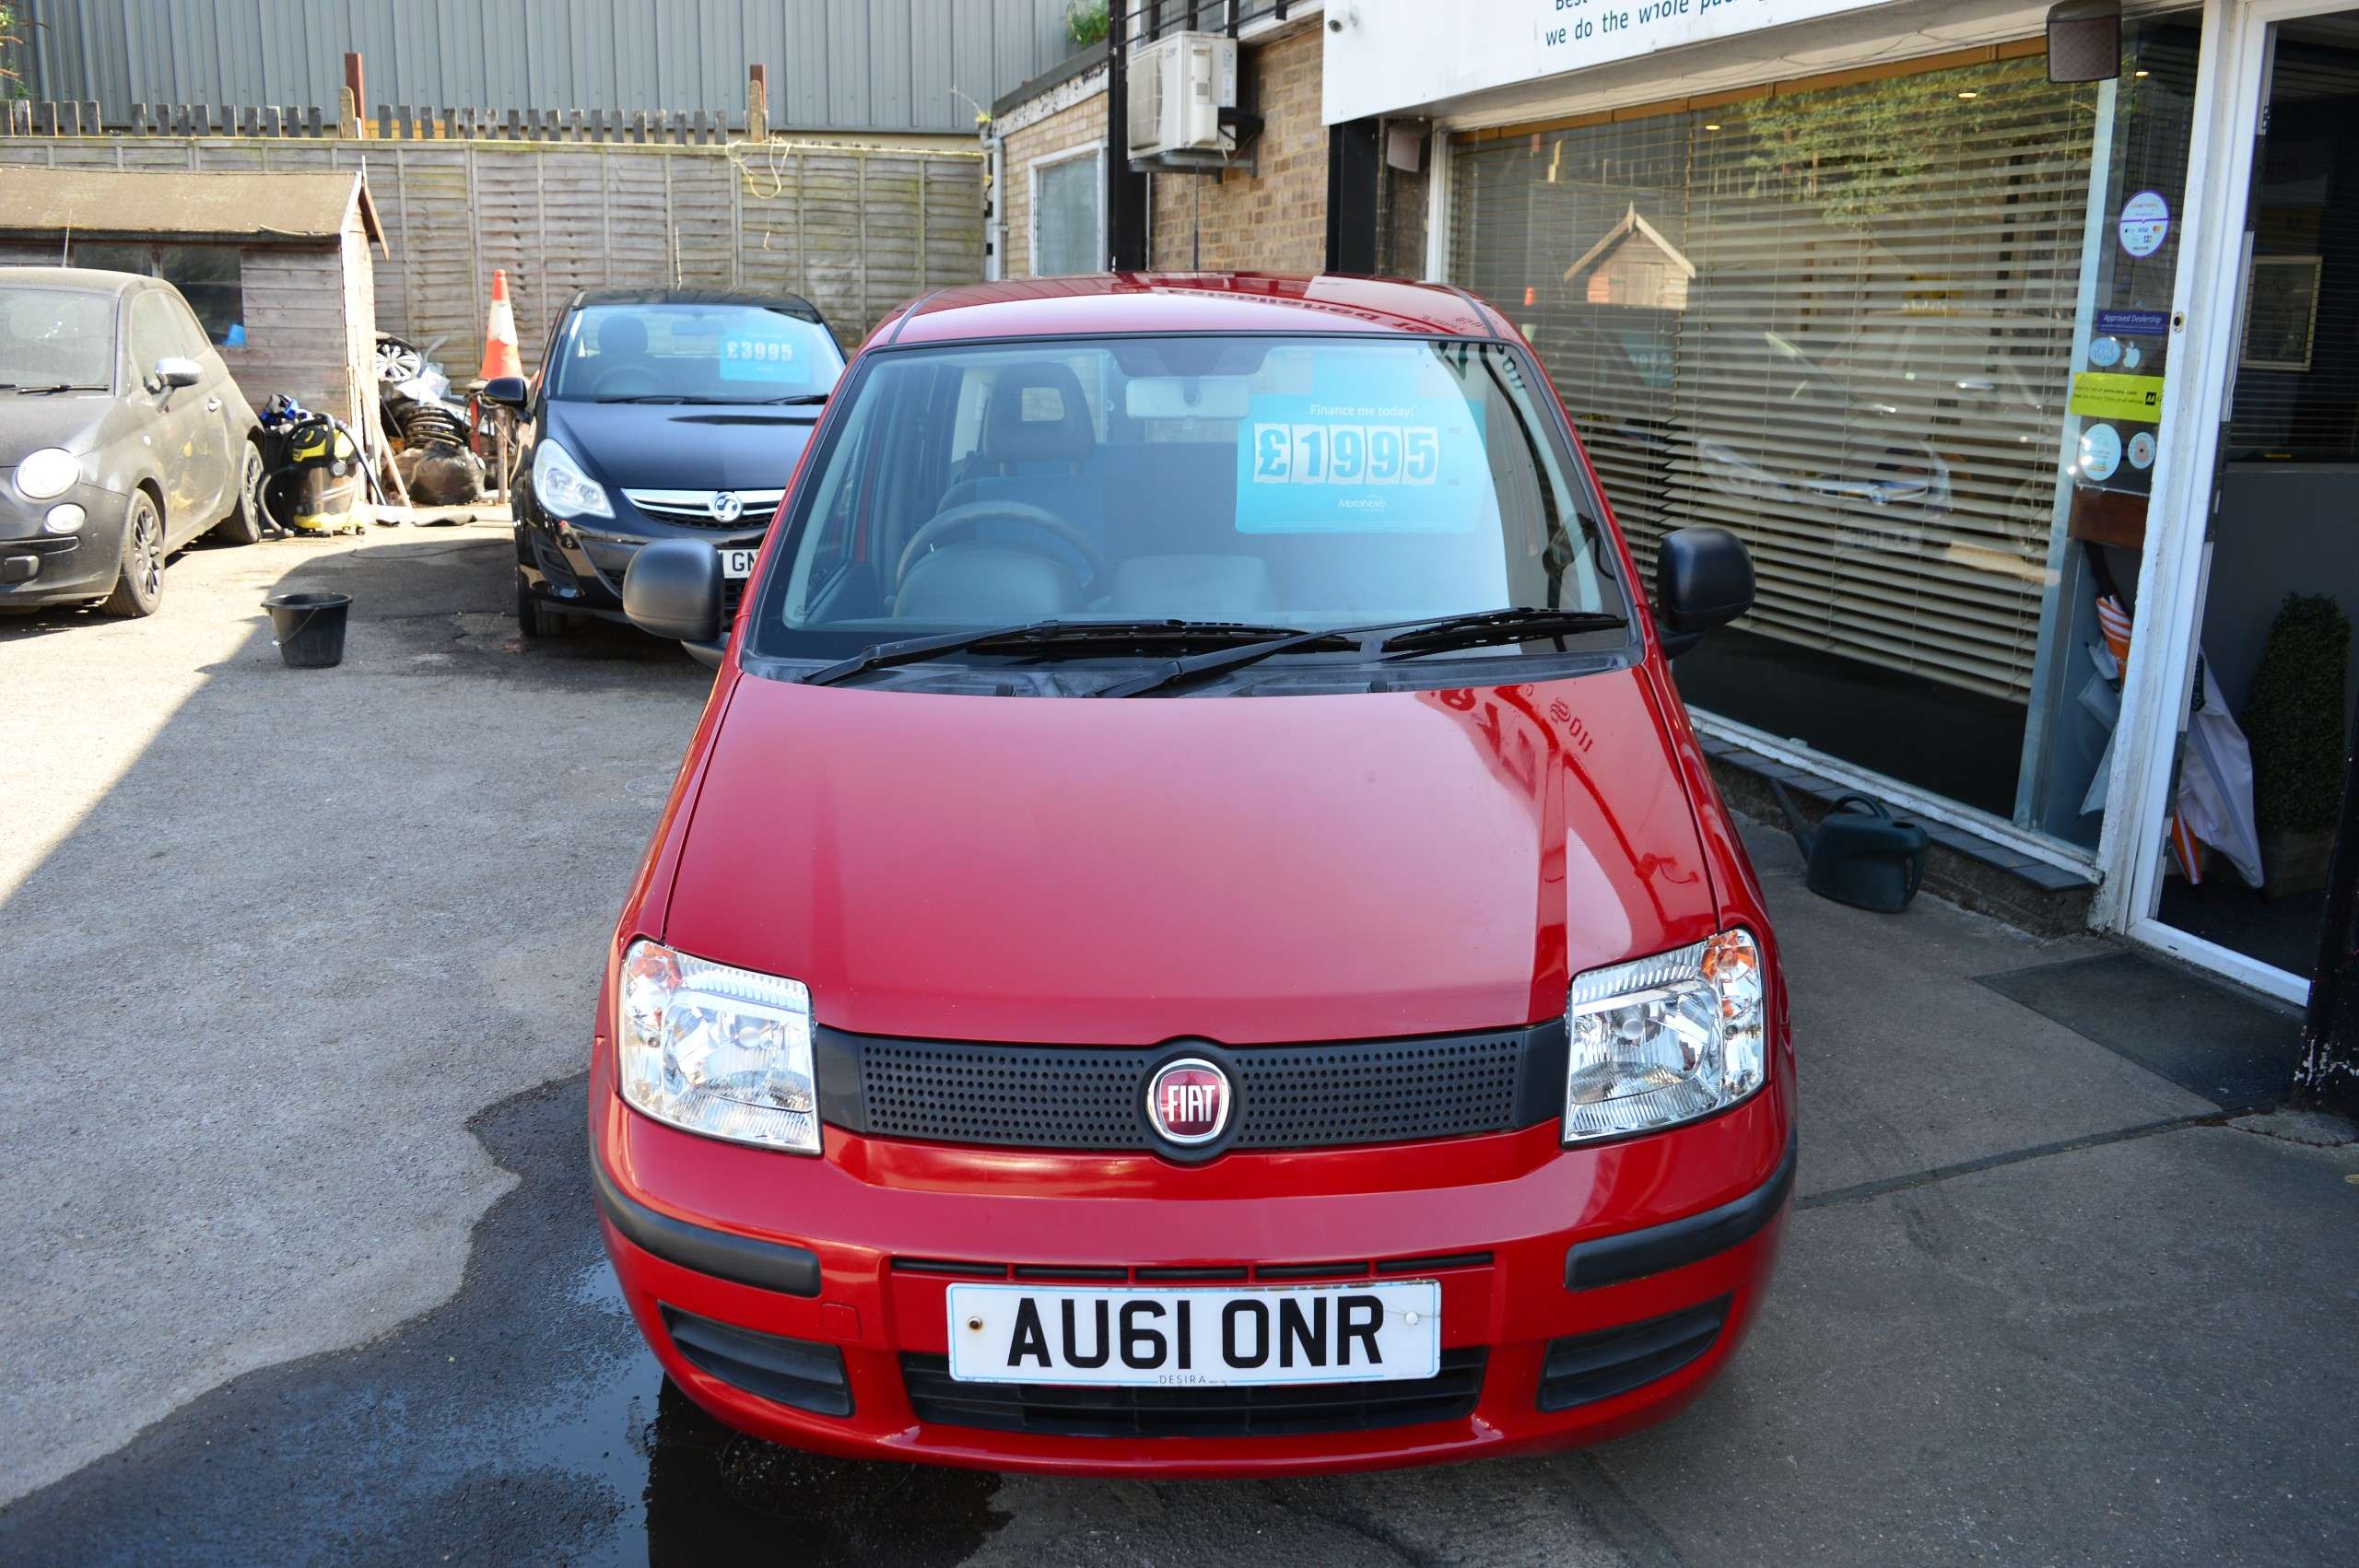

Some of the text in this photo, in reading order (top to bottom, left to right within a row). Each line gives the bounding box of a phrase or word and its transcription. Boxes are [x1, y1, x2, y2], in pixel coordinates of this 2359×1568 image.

[1545, 28, 1567, 46] we
[1575, 18, 1593, 40] do
[1602, 9, 1629, 33] the
[2103, 313, 2162, 325] Approved Dealership
[726, 340, 793, 362] £3995
[1310, 404, 1417, 420] Finance me today!
[1258, 428, 1436, 479] £1995
[1168, 1084, 1216, 1122] FIAT
[1007, 1294, 1384, 1370] AU61 ONR
[1159, 1375, 1207, 1385] DESIRA
